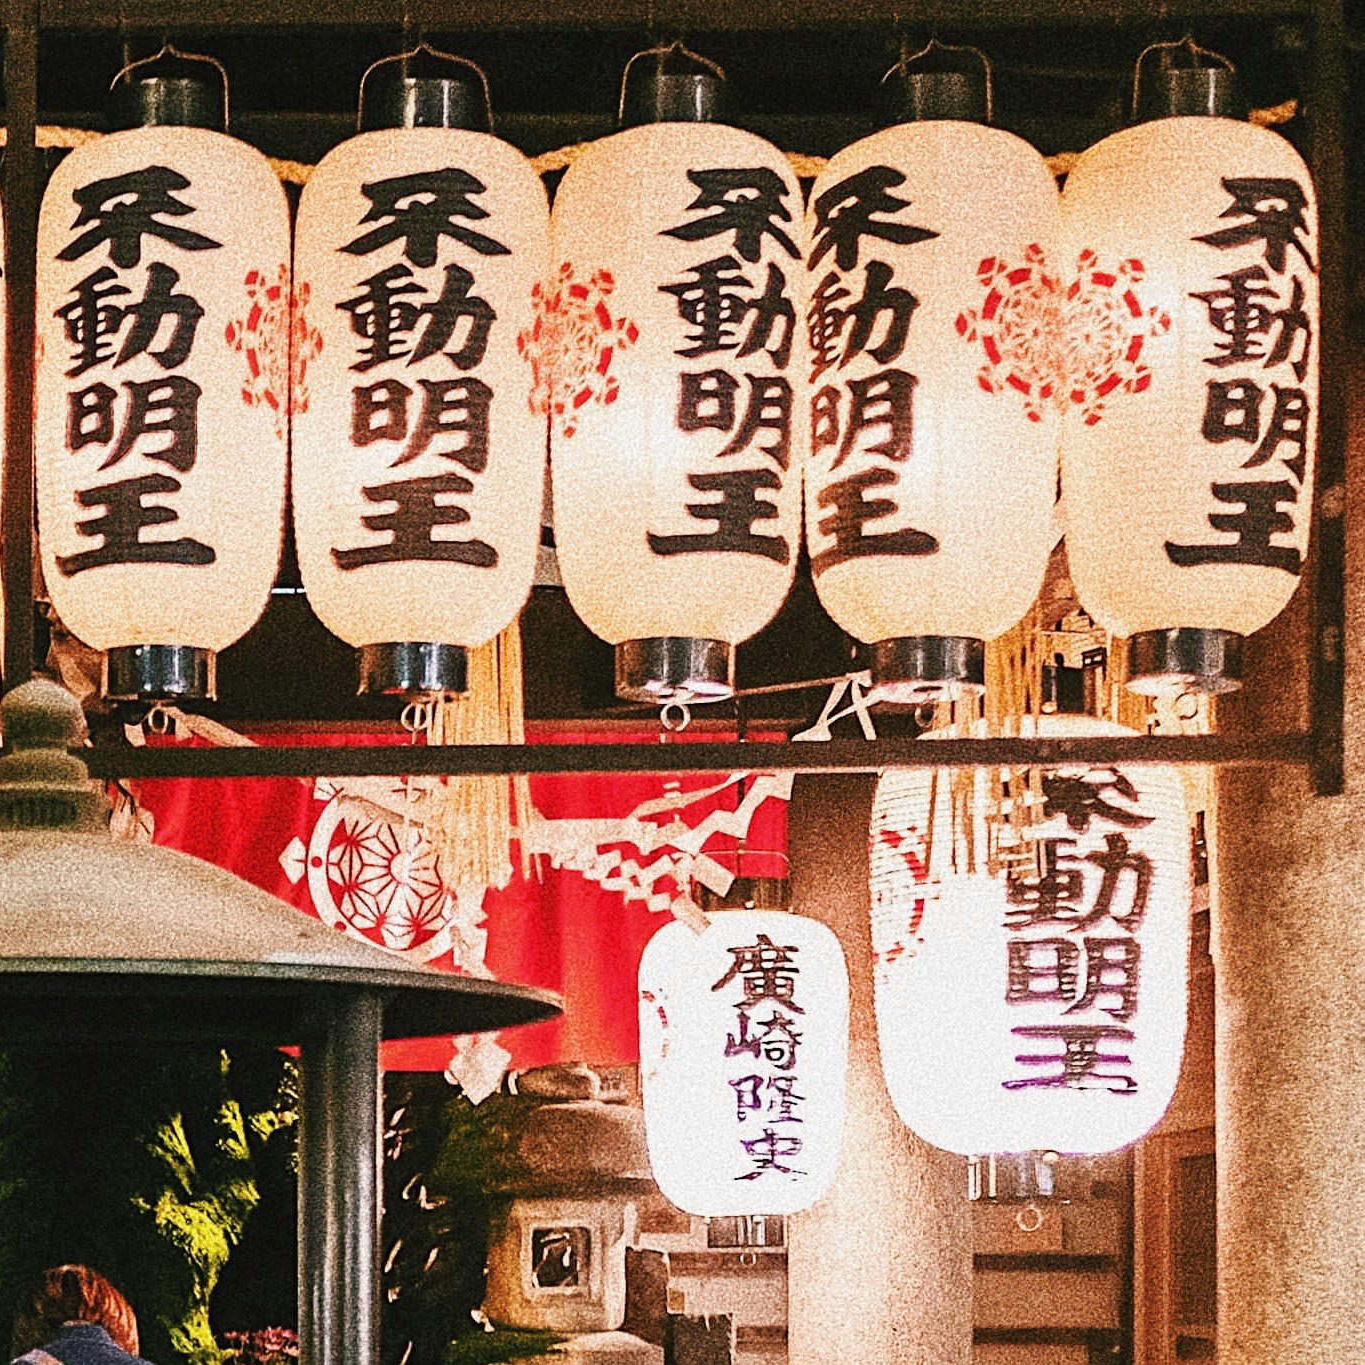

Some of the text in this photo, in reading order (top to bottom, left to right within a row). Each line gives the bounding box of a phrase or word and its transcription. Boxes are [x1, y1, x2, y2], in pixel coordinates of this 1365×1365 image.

[53, 165, 224, 577] 不動明王
[330, 166, 512, 572] 不動明王
[646, 166, 804, 566] 不動明王
[805, 165, 941, 579] 不動明王
[1163, 176, 1318, 577] 不動明王
